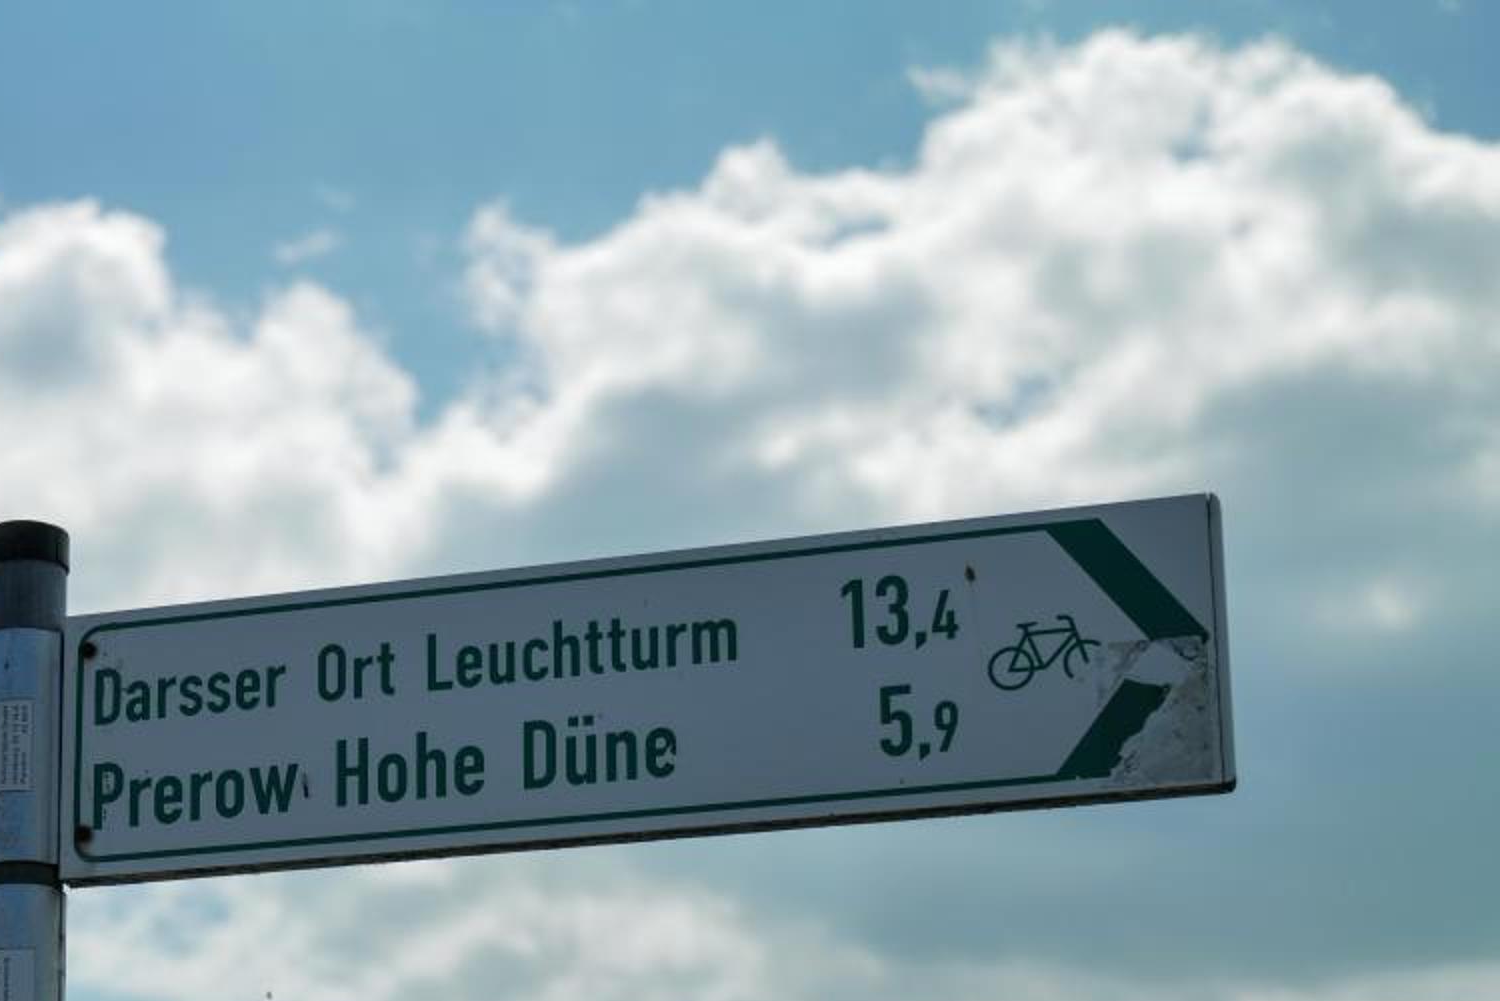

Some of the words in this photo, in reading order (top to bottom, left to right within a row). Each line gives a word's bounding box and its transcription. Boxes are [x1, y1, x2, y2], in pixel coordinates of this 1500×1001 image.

[94, 664, 286, 726] Darsser
[317, 641, 396, 702] Ort
[426, 617, 738, 692] Leuchtturm
[841, 574, 959, 649] 13,4
[93, 761, 298, 830] Prerow
[336, 731, 485, 807] Hohe
[523, 714, 678, 791] Düne
[879, 684, 959, 761] 5,9
